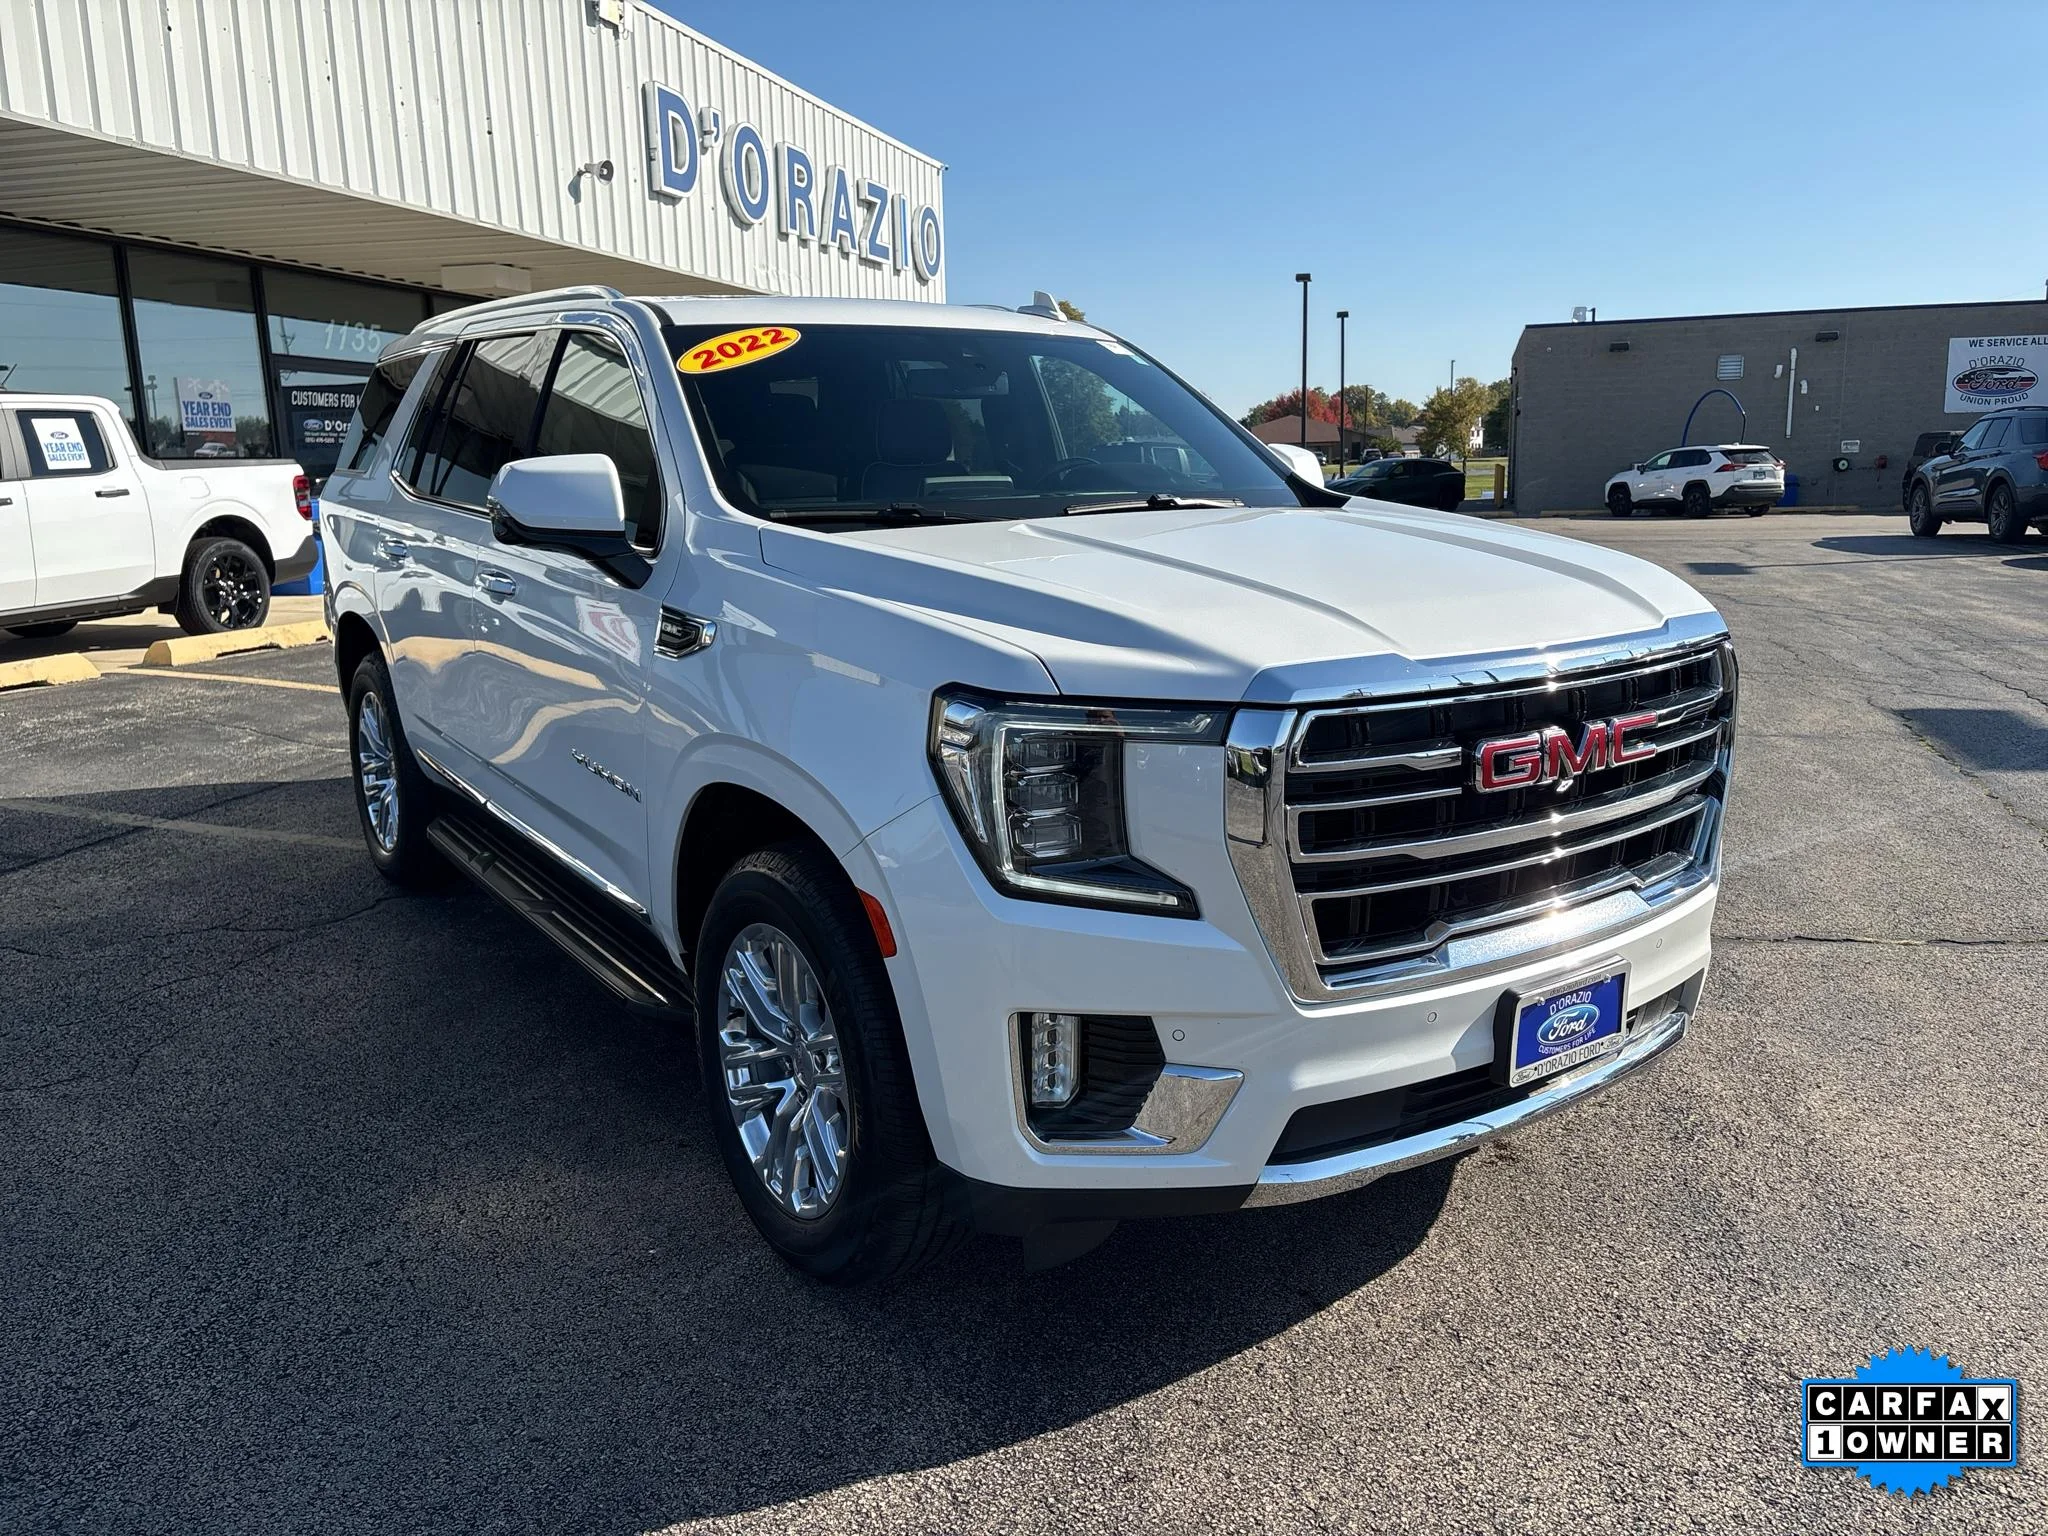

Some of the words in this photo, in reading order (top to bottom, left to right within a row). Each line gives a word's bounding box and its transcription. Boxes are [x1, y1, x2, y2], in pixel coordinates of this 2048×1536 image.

[645, 80, 941, 281] D'ORAZIO
[325, 319, 381, 353] 1135
[1968, 338, 1985, 348] WE
[1986, 337, 2029, 347] SERVICE
[2030, 336, 2048, 346] ALL
[693, 328, 791, 370] 2022
[1968, 355, 2025, 369] D'ORAZIO
[1968, 370, 2023, 390] Ford
[182, 400, 210, 416] YEAR
[211, 401, 232, 417] END
[291, 390, 339, 407] CUSTOMERS
[340, 393, 355, 408] FOR
[1960, 393, 1992, 406] UNION
[1994, 392, 2029, 405] PROUD
[185, 416, 209, 428] SALES
[210, 416, 232, 428] EVENT
[43, 442, 66, 453] YEAR
[66, 442, 83, 452] END
[48, 453, 67, 461] SALES
[662, 621, 682, 637] GMC
[1473, 710, 1658, 793] GMC
[571, 748, 642, 803] YUKON
[1550, 991, 1592, 1015] D'ORAZIO
[1548, 1010, 1589, 1040] Ford
[1538, 1043, 1571, 1055] CUSTOMERS
[1572, 1036, 1584, 1047] FOR
[1584, 1026, 1597, 1040] LIFE
[1536, 1050, 1577, 1076] D'ORAZIO
[1579, 1041, 1601, 1060] FORD
